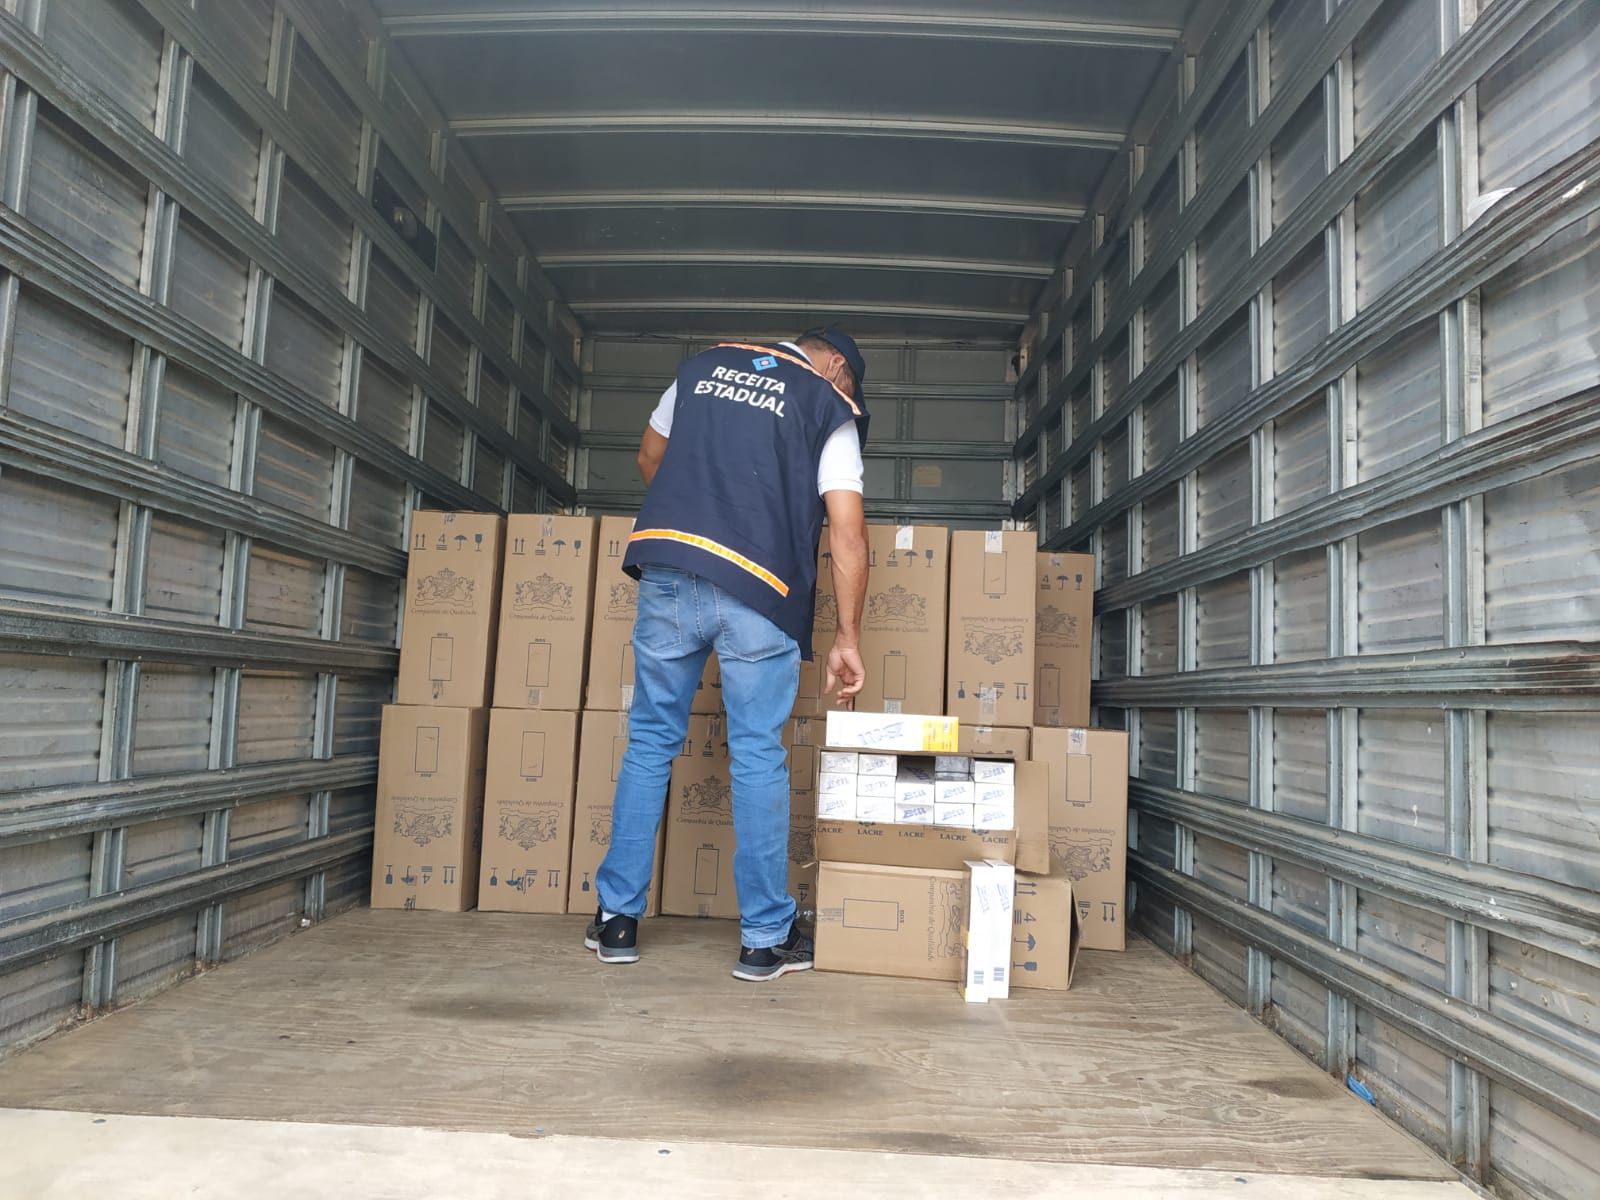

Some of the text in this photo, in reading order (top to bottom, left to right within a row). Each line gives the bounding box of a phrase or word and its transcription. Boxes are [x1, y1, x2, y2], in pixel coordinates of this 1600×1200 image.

[712, 366, 786, 394] RECEITA
[693, 380, 785, 417] ESTADUAL
[940, 833, 967, 842] LACRE
[982, 836, 1009, 844] LACRE
[1023, 912, 1037, 923] 4
